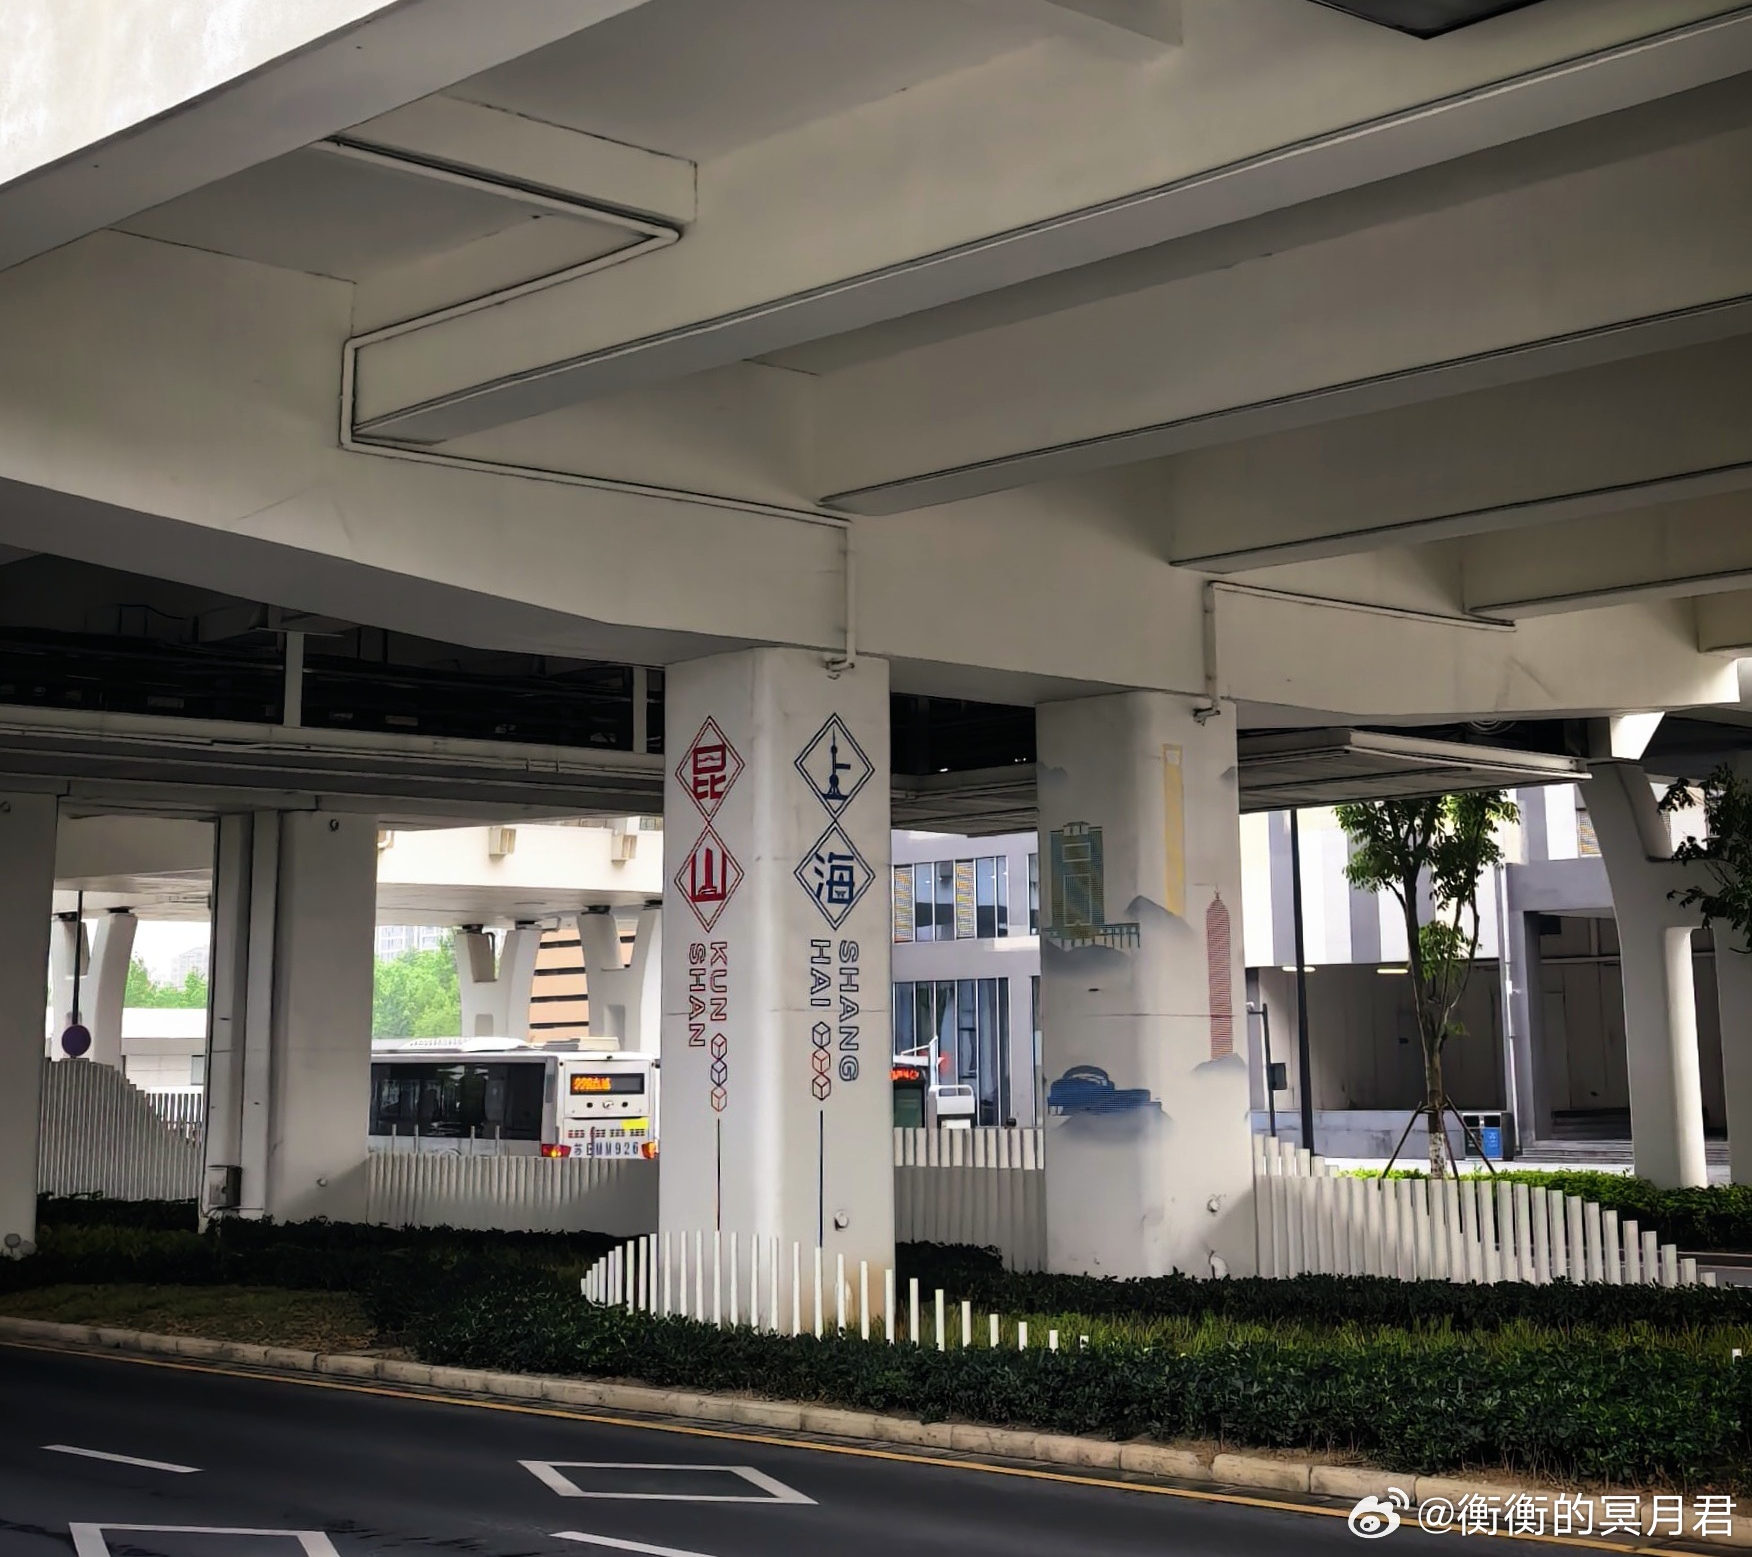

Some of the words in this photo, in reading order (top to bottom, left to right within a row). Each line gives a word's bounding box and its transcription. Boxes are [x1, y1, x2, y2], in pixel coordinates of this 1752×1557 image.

[690, 744, 727, 903] 昆山
[813, 726, 855, 904] 上海
[689, 943, 706, 1047] SHAN
[710, 941, 728, 1021] KUN
[811, 939, 831, 1007] HAI
[839, 940, 859, 1082] SHANG
